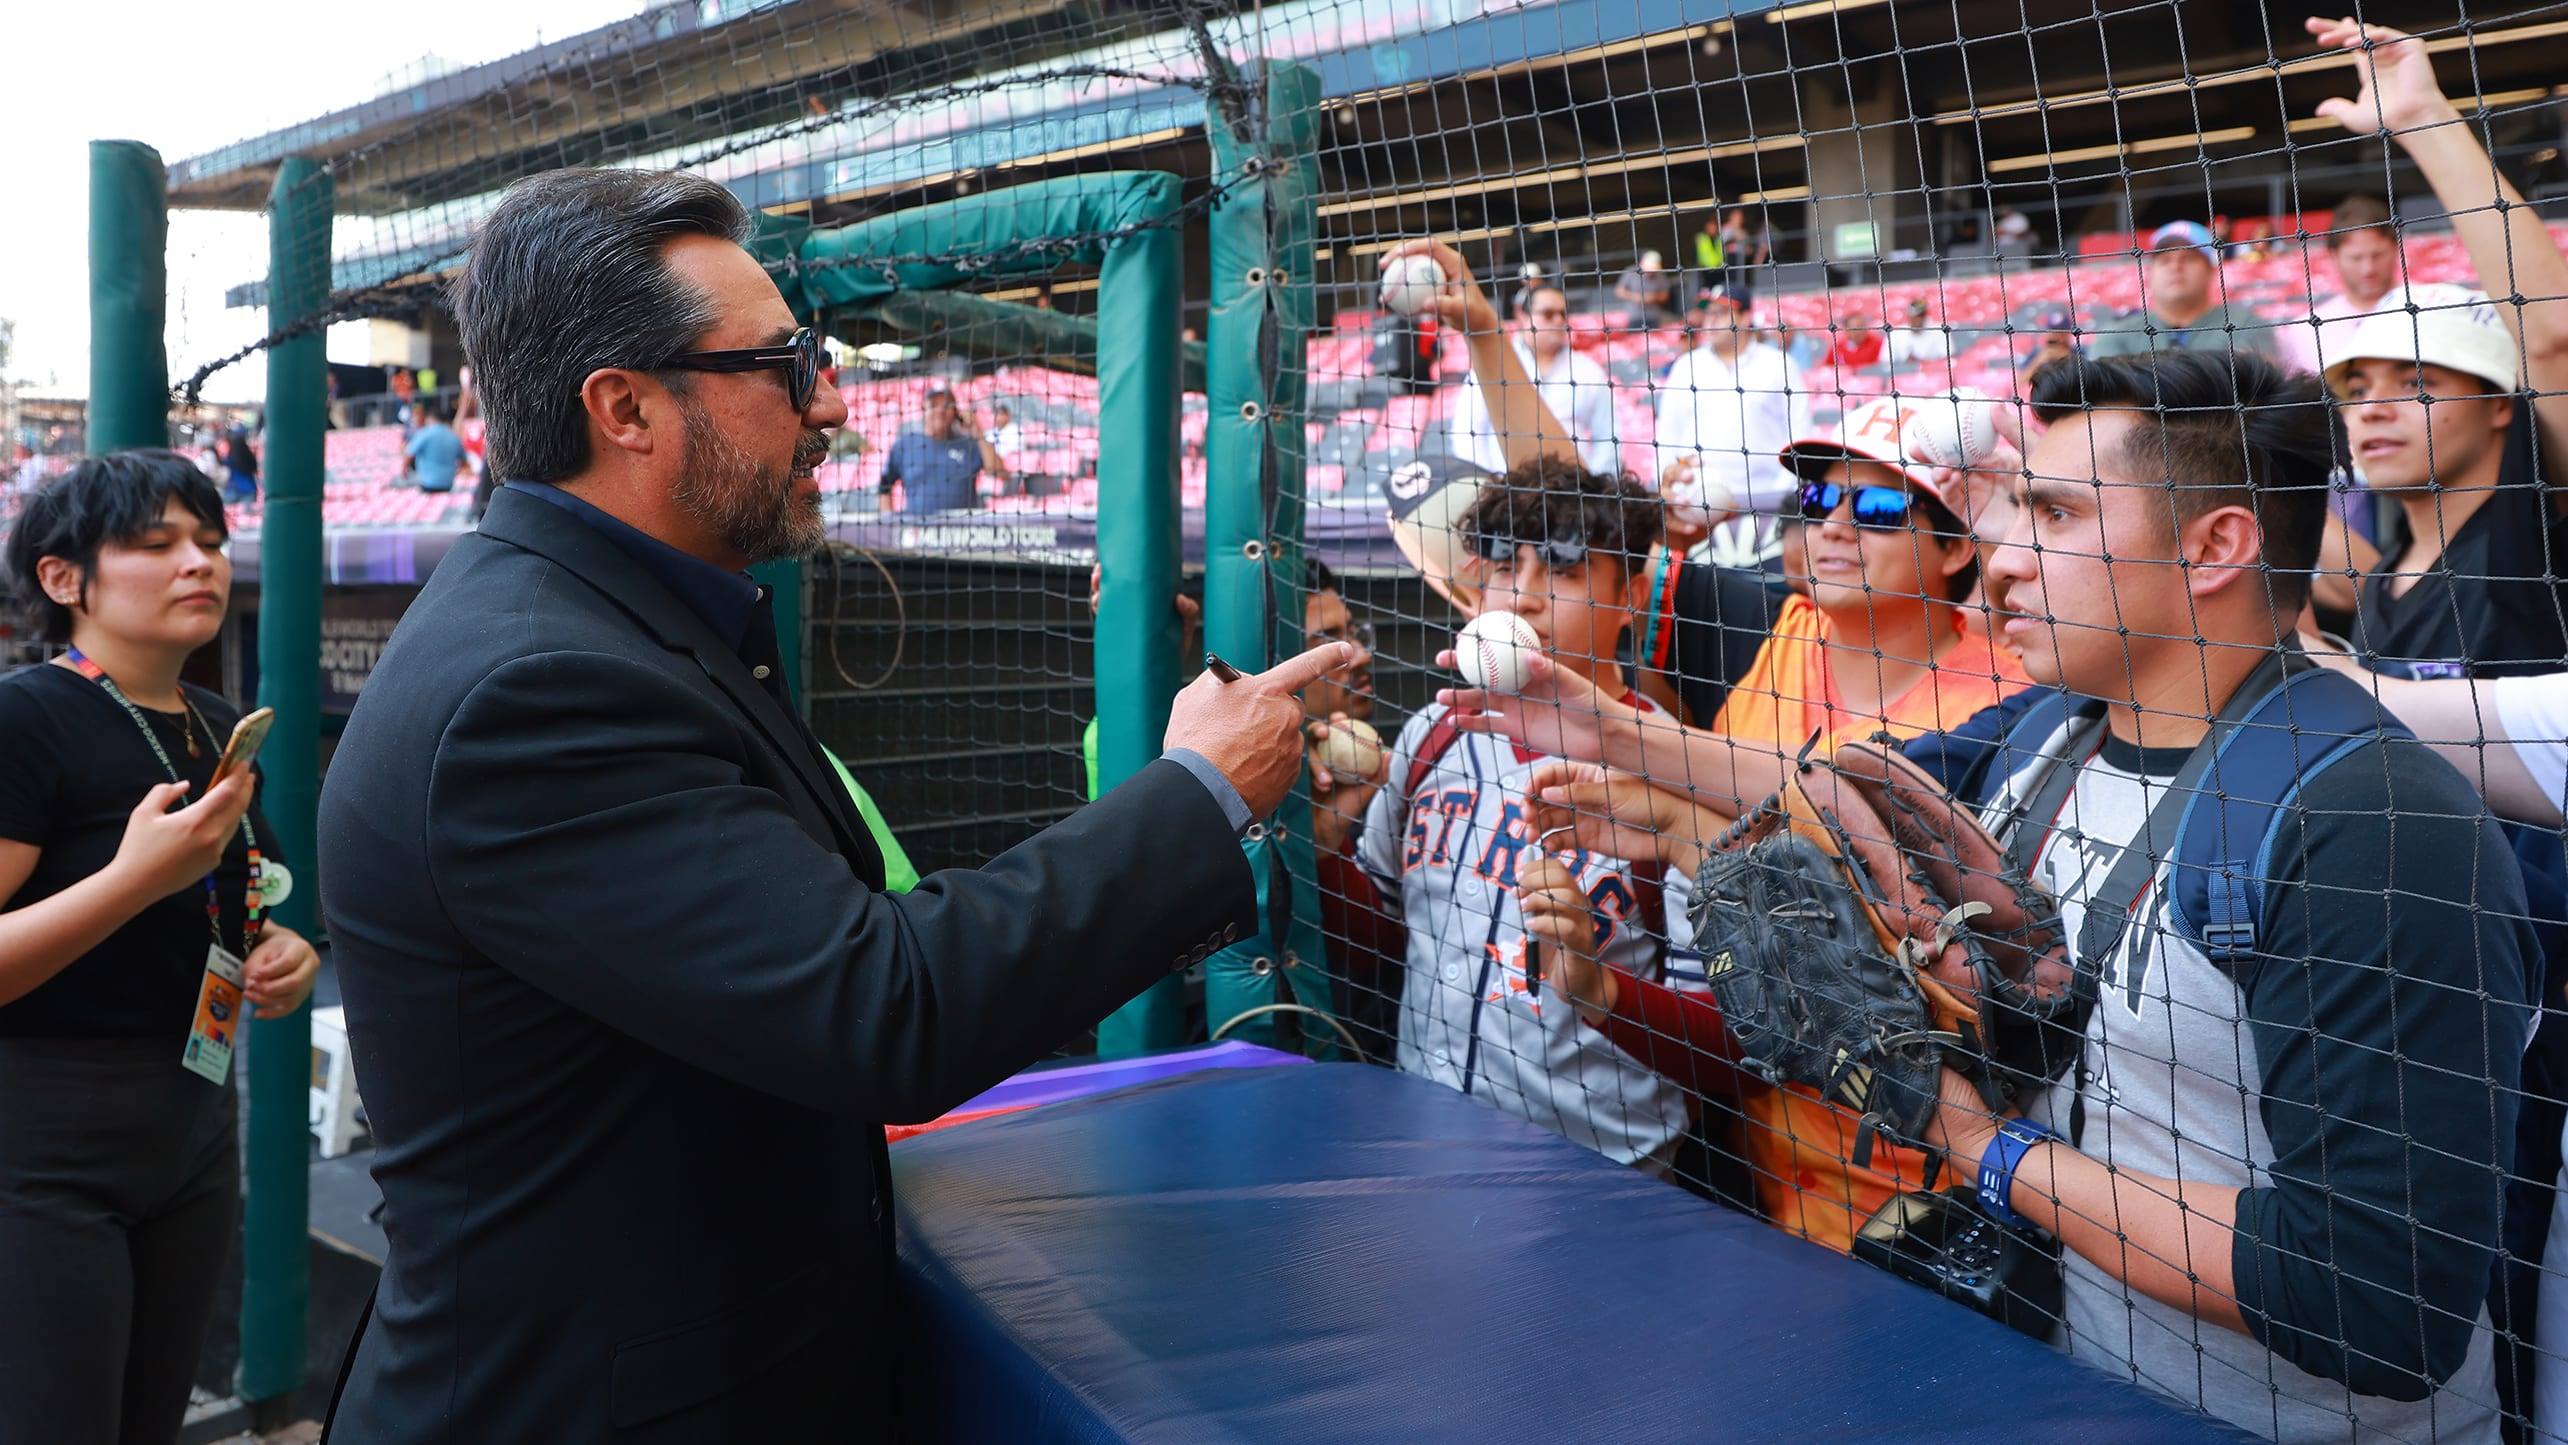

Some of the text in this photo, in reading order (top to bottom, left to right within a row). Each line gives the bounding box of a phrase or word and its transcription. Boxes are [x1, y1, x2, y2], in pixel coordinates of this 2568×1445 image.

[957, 127, 1061, 169] MEXICO
[1062, 109, 1131, 147] CITY
[1855, 404, 1916, 445] H
[951, 526, 1010, 548] WORLD
